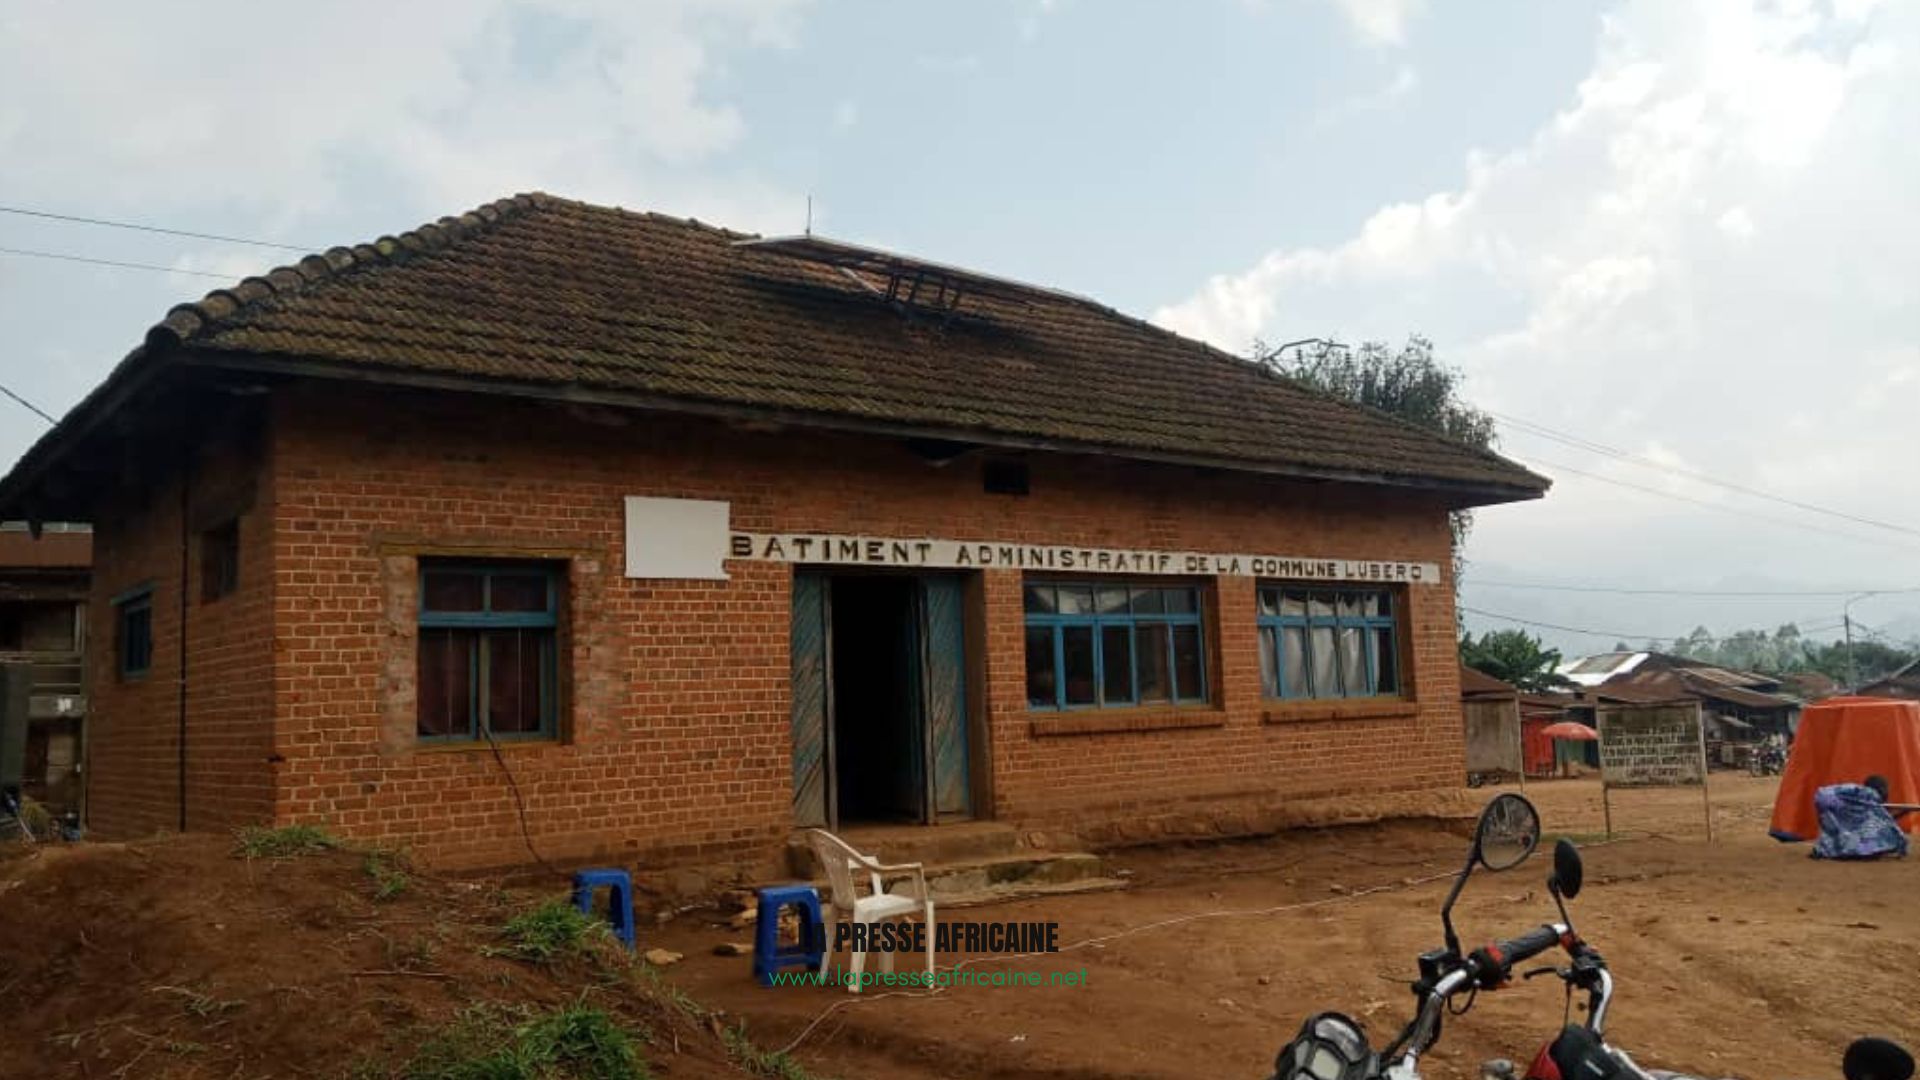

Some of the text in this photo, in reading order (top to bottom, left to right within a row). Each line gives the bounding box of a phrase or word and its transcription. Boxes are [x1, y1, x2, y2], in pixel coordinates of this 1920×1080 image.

[732, 535, 1422, 580] BATIMENT ADMINISTRATIF DE LA COMMUNE LUBERO
